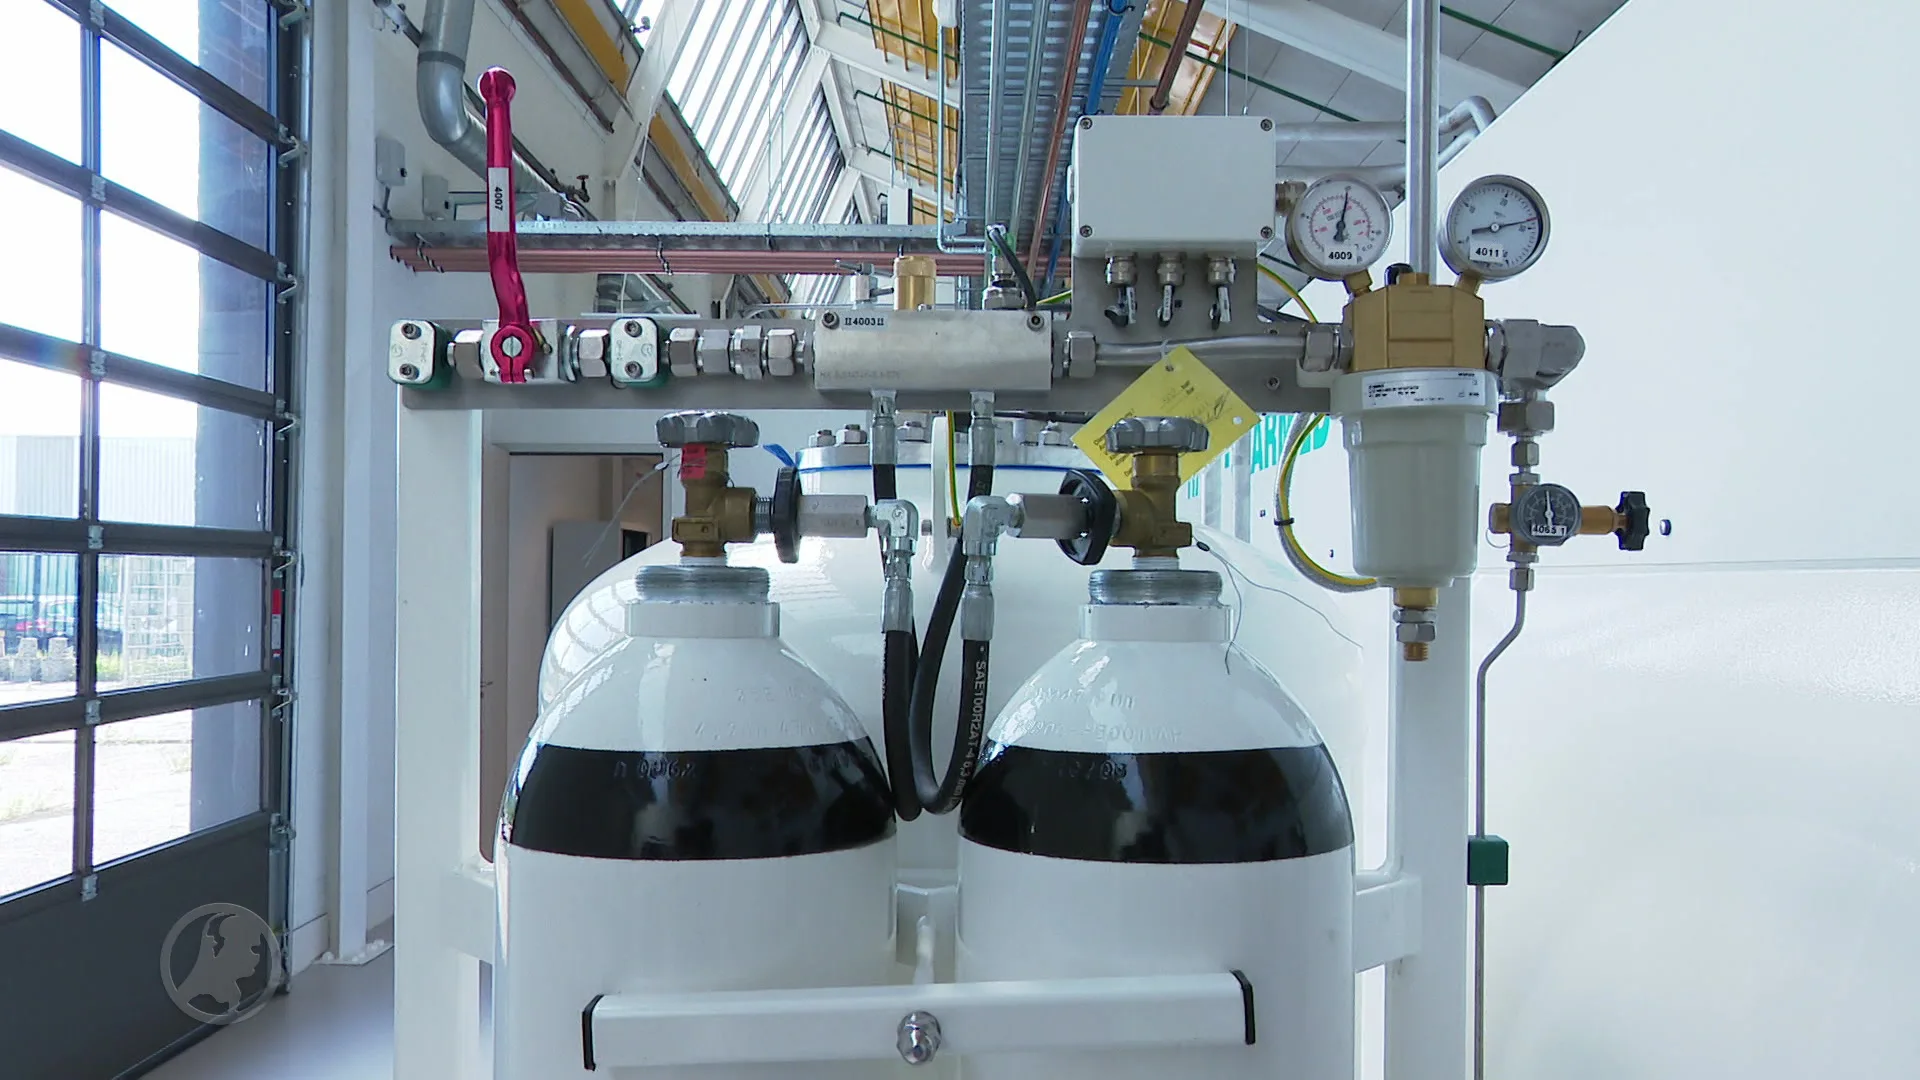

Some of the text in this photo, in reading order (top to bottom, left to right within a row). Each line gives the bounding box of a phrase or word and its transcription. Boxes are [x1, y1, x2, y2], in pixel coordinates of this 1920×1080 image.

[494, 186, 504, 212] 4007
[1328, 251, 1353, 260] 4009
[1475, 247, 1500, 258] 4011
